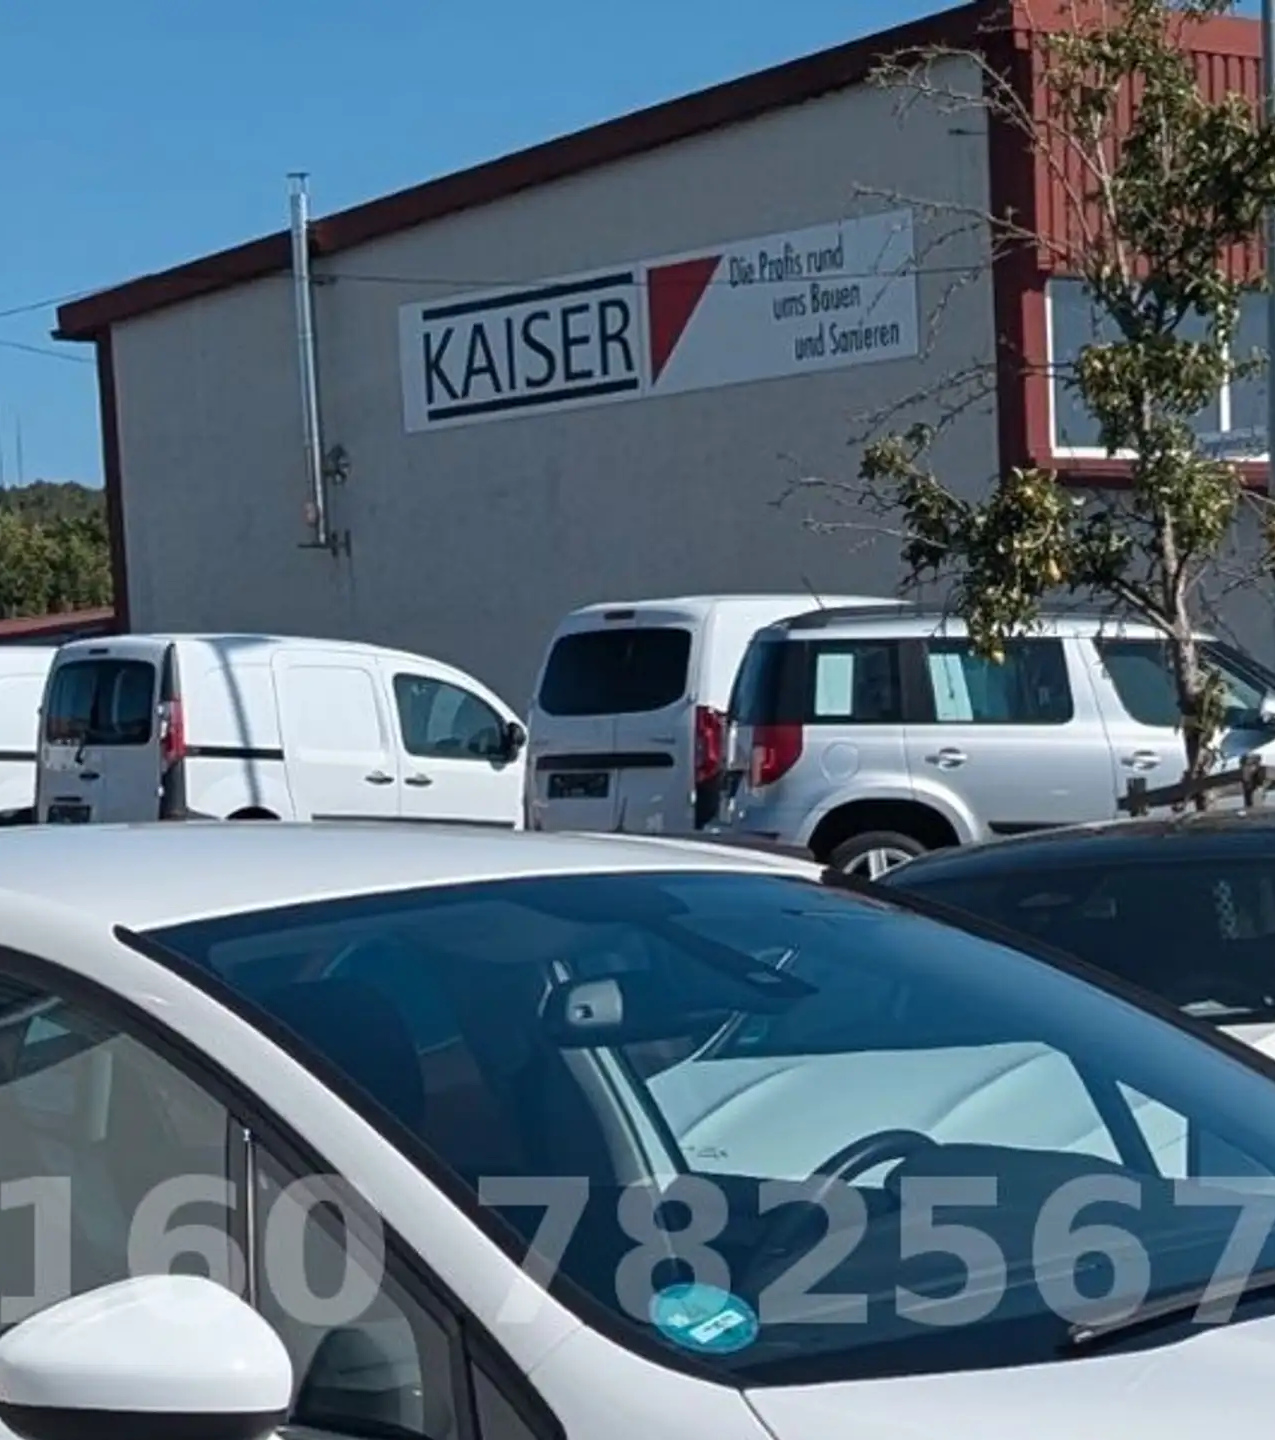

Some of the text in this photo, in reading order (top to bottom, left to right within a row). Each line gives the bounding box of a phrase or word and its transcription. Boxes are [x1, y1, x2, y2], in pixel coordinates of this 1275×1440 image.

[729, 232, 844, 288] Die Profis rund
[773, 282, 861, 321] ums Bauen
[423, 298, 635, 405] KAISER
[794, 317, 900, 361] und Sanieren
